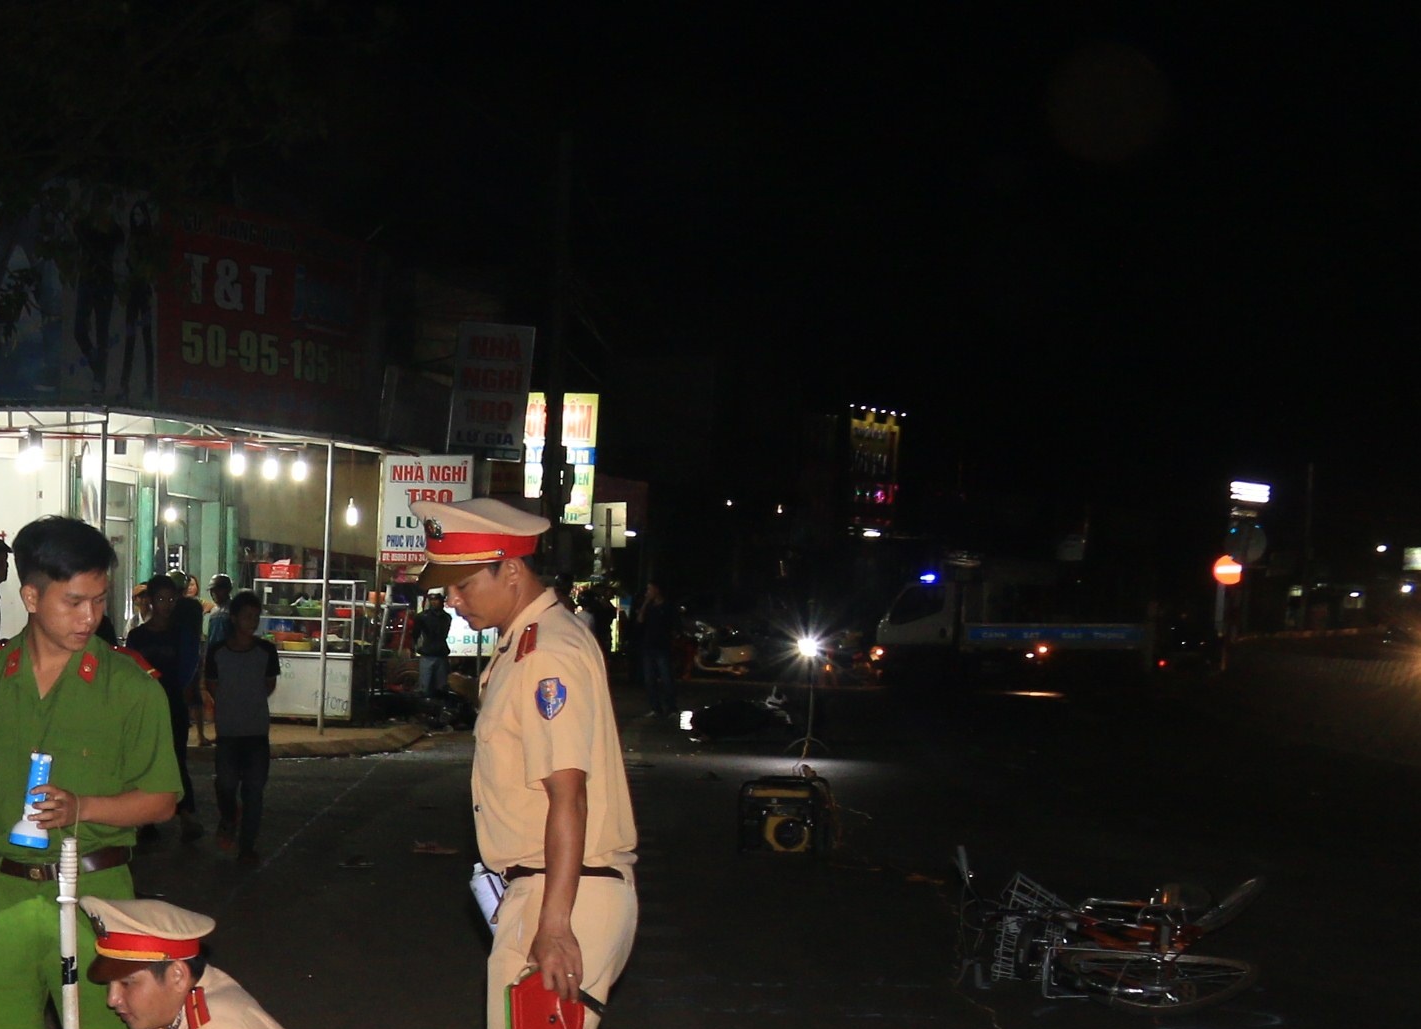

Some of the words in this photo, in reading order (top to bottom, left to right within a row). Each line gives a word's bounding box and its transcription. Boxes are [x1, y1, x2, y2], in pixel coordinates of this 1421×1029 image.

[183, 251, 273, 316] T&T
[484, 431, 514, 446] GIA
[391, 460, 425, 481] NHÀ
[428, 460, 468, 482] NGHỈ
